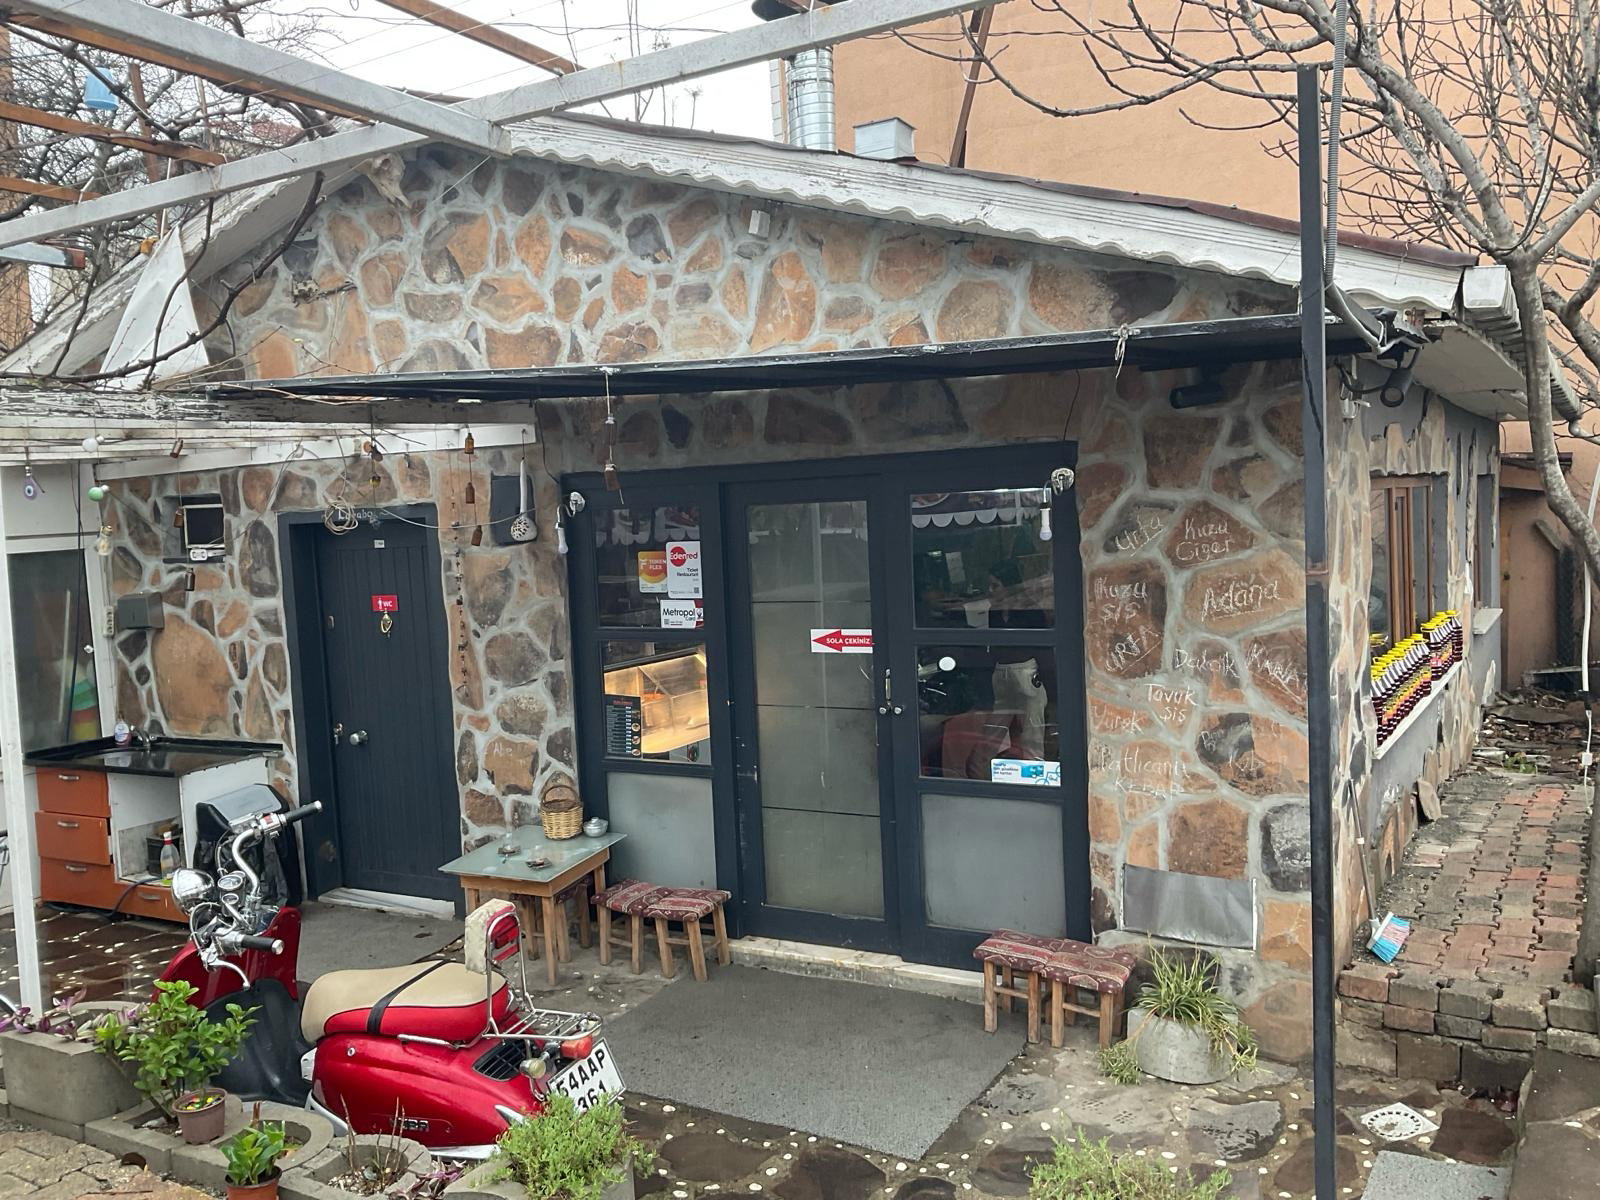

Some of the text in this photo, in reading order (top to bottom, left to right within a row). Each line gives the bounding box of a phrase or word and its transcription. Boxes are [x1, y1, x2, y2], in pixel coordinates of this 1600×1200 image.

[662, 607, 695, 618] Metropol
[826, 637, 871, 645] SOLA ÇEKİNİZ
[1143, 683, 1200, 706] Tavuk
